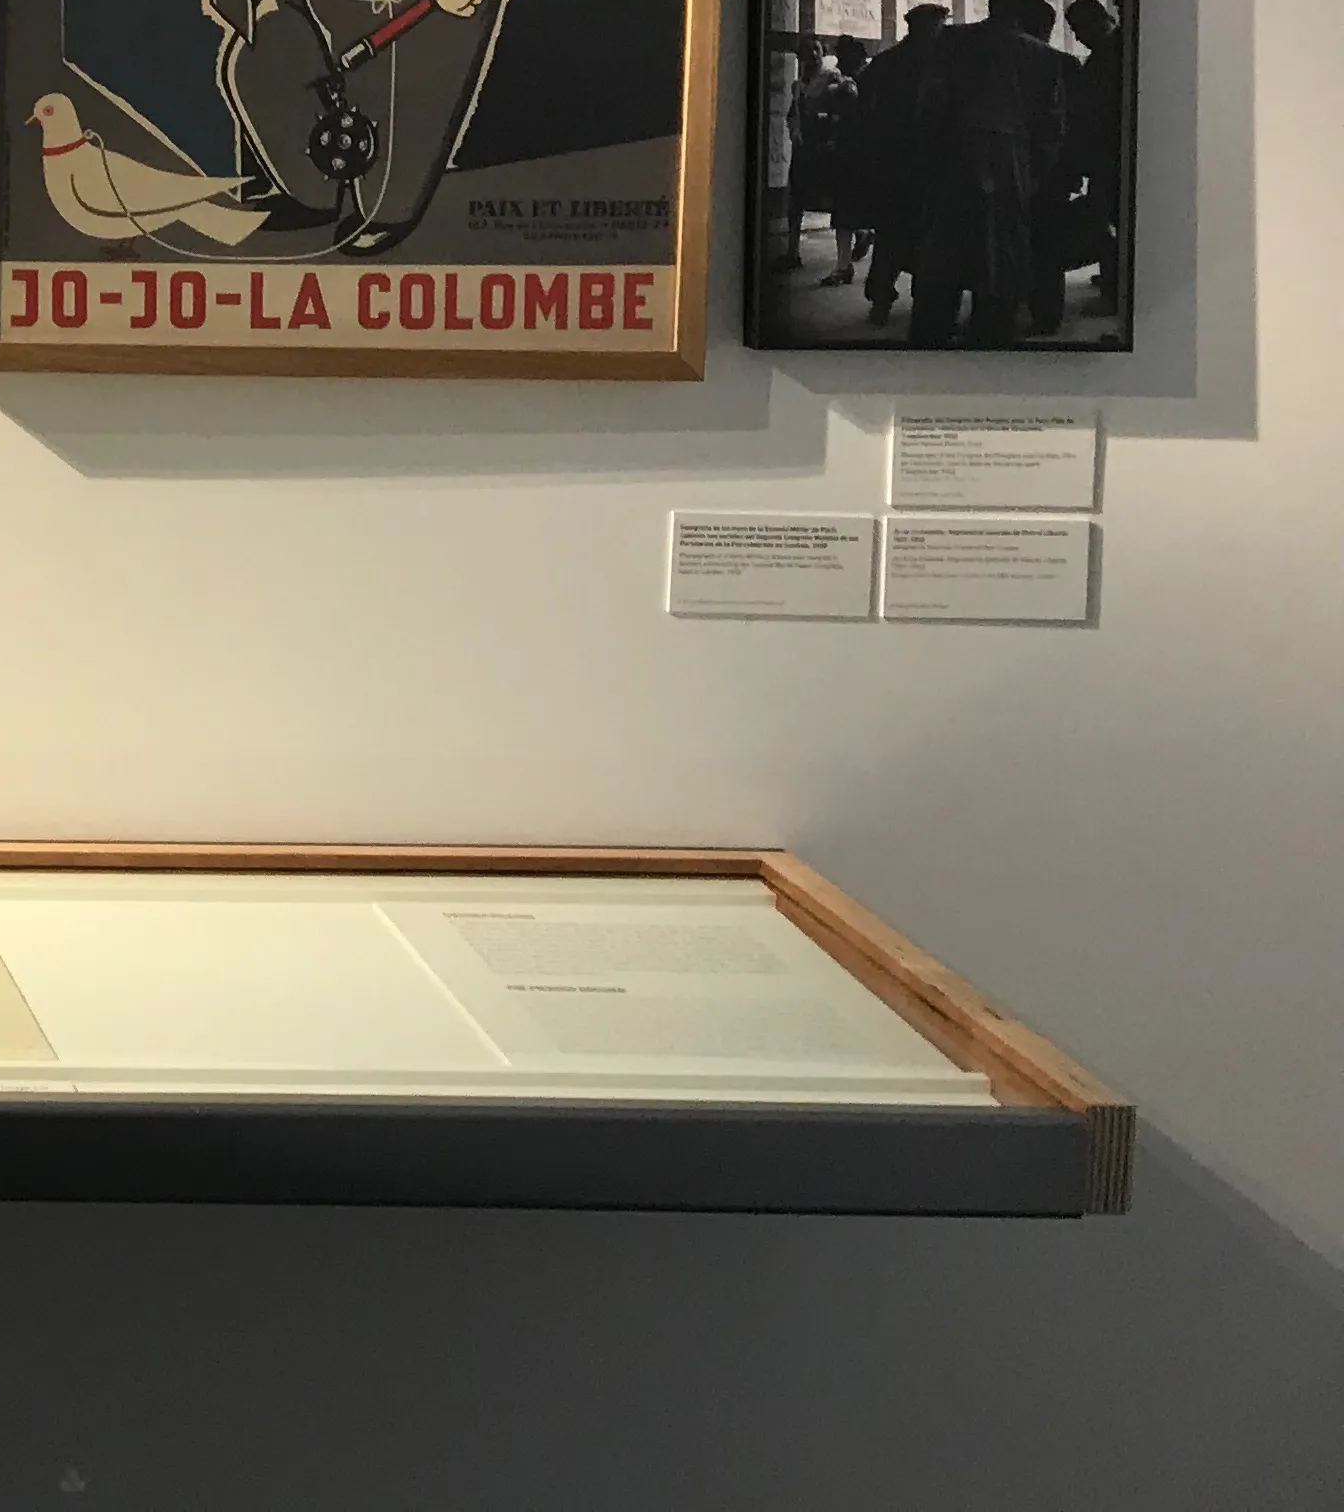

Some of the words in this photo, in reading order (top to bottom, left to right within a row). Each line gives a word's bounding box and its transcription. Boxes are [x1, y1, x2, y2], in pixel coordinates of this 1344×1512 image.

[468, 200, 523, 217] PAIX
[532, 200, 562, 217] ET
[570, 195, 670, 217] LIBERTÉ
[357, 272, 656, 332] COLOMBE
